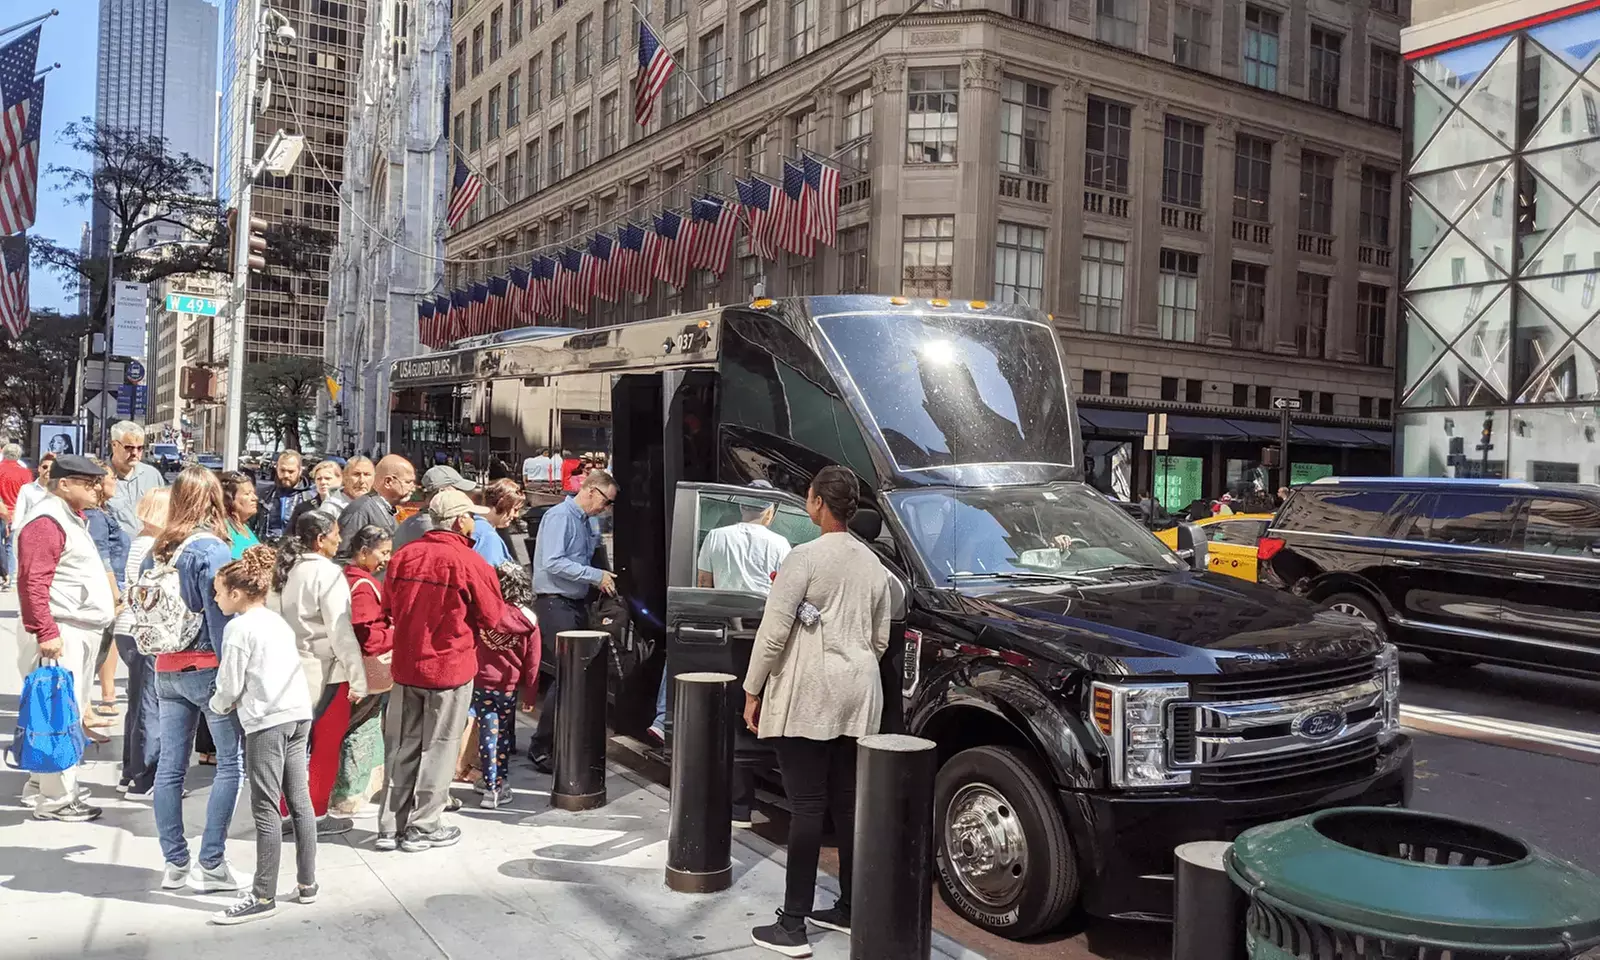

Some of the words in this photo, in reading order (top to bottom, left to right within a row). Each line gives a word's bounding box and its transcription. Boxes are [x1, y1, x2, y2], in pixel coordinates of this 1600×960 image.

[171, 294, 181, 310] W
[186, 298, 204, 311] 49
[677, 333, 695, 350] 037
[399, 361, 411, 378] USA
[412, 361, 431, 377] GUIDED
[431, 359, 450, 376] TOURS
[1309, 715, 1337, 734] Ford
[952, 891, 978, 917] GUARD
[979, 913, 1010, 926] STRONG
